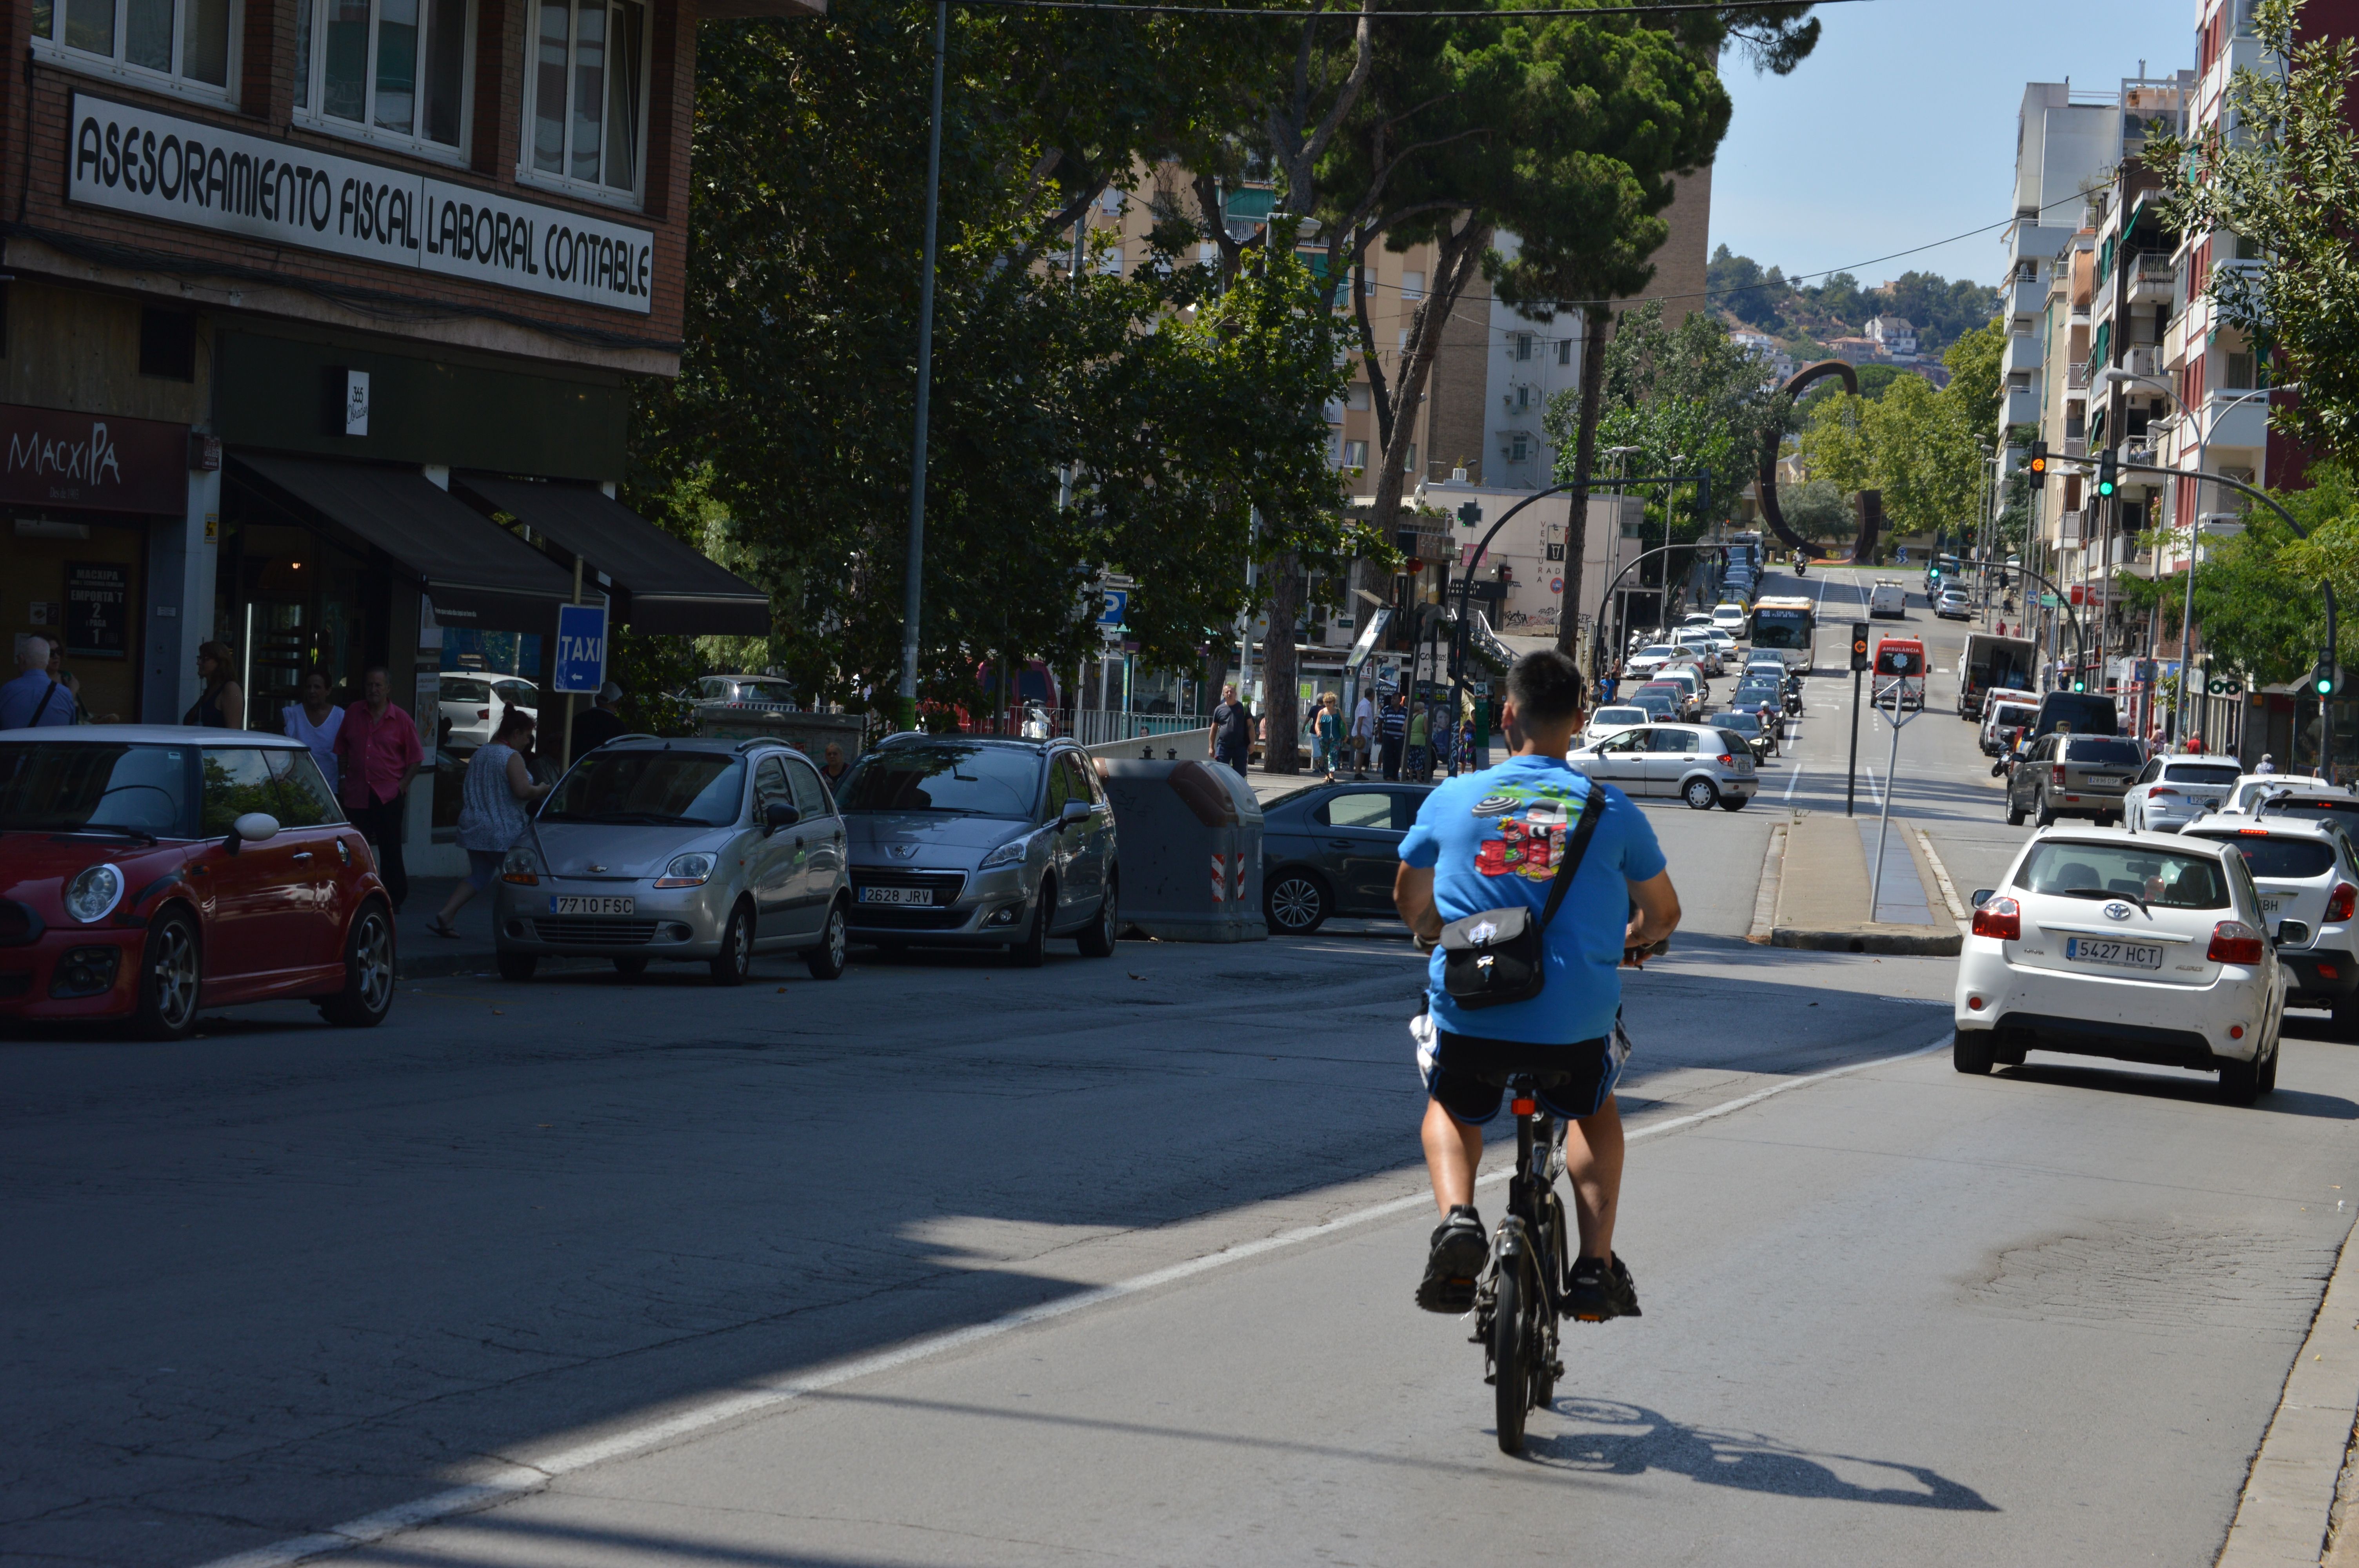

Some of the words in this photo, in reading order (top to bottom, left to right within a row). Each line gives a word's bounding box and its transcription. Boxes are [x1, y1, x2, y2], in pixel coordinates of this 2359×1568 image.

[77, 117, 331, 232] ASESORAMIENTO
[339, 178, 418, 249] FISCAL
[427, 196, 538, 275] LABORAL
[545, 224, 649, 297] CONTABLE
[353, 386, 363, 403] 365
[347, 403, 368, 424] Obrador
[1537, 521, 1546, 583] VENTURA
[76, 569, 118, 581] MACXIPA
[93, 602, 101, 618] 2
[1099, 594, 1120, 620] P
[89, 619, 106, 627] PAGA
[93, 629, 99, 644] 1
[562, 636, 602, 662] TAXI
[1420, 652, 1447, 661] COREOS
[867, 889, 899, 901] 2628
[905, 890, 929, 902] JRV
[560, 898, 598, 912] 7710
[604, 899, 631, 913] FSC
[2260, 900, 2278, 911] BH
[2080, 942, 2120, 958] 5427
[2126, 947, 2157, 964] HCT
